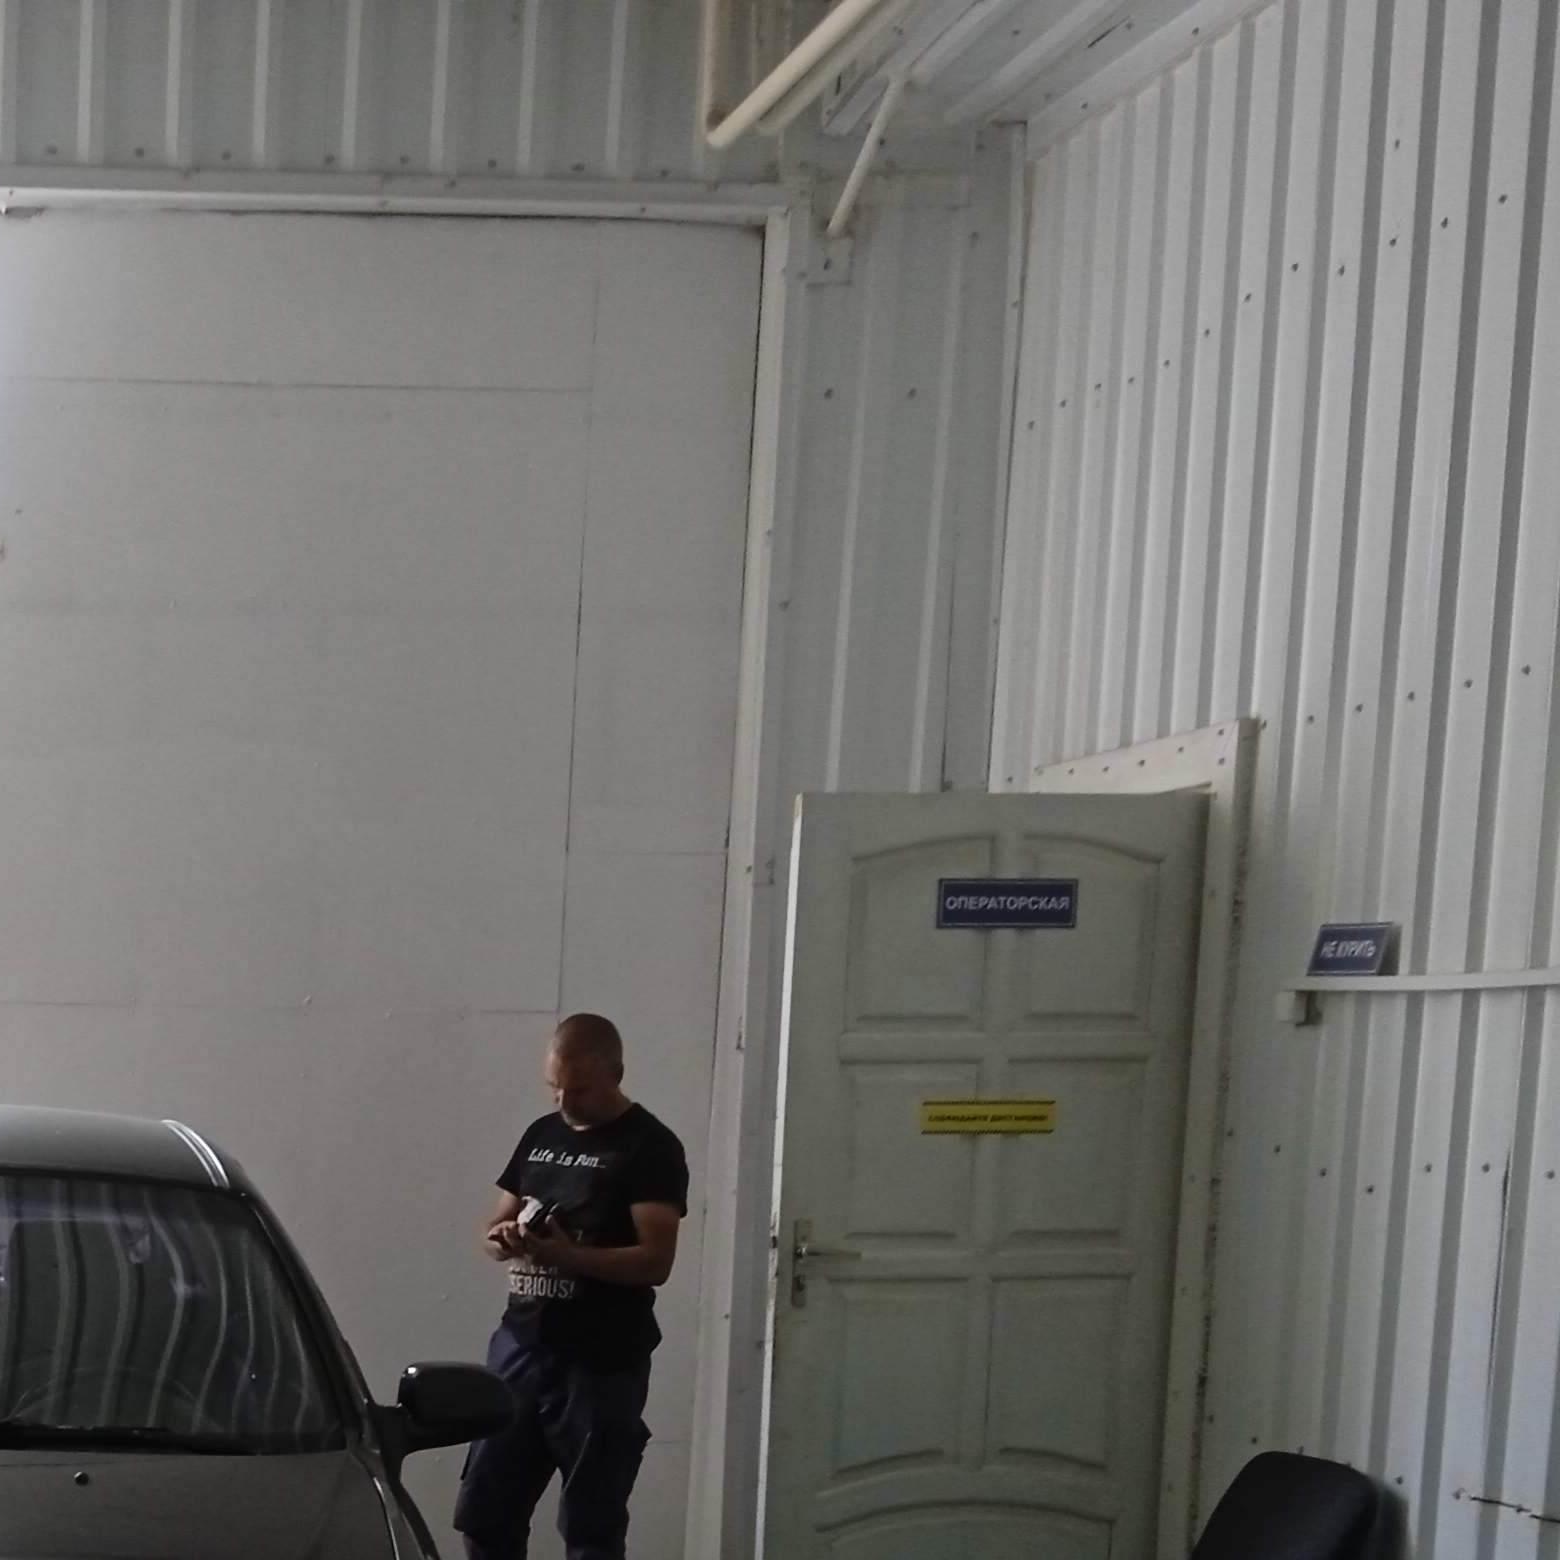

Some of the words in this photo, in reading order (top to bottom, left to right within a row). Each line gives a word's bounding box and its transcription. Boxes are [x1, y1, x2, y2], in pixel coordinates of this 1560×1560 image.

[945, 896, 1071, 910] ОПЕРАТОРСКАЯ
[528, 1148, 554, 1163] Life
[556, 1152, 574, 1167] is
[509, 1276, 575, 1299] SERIOUS!
